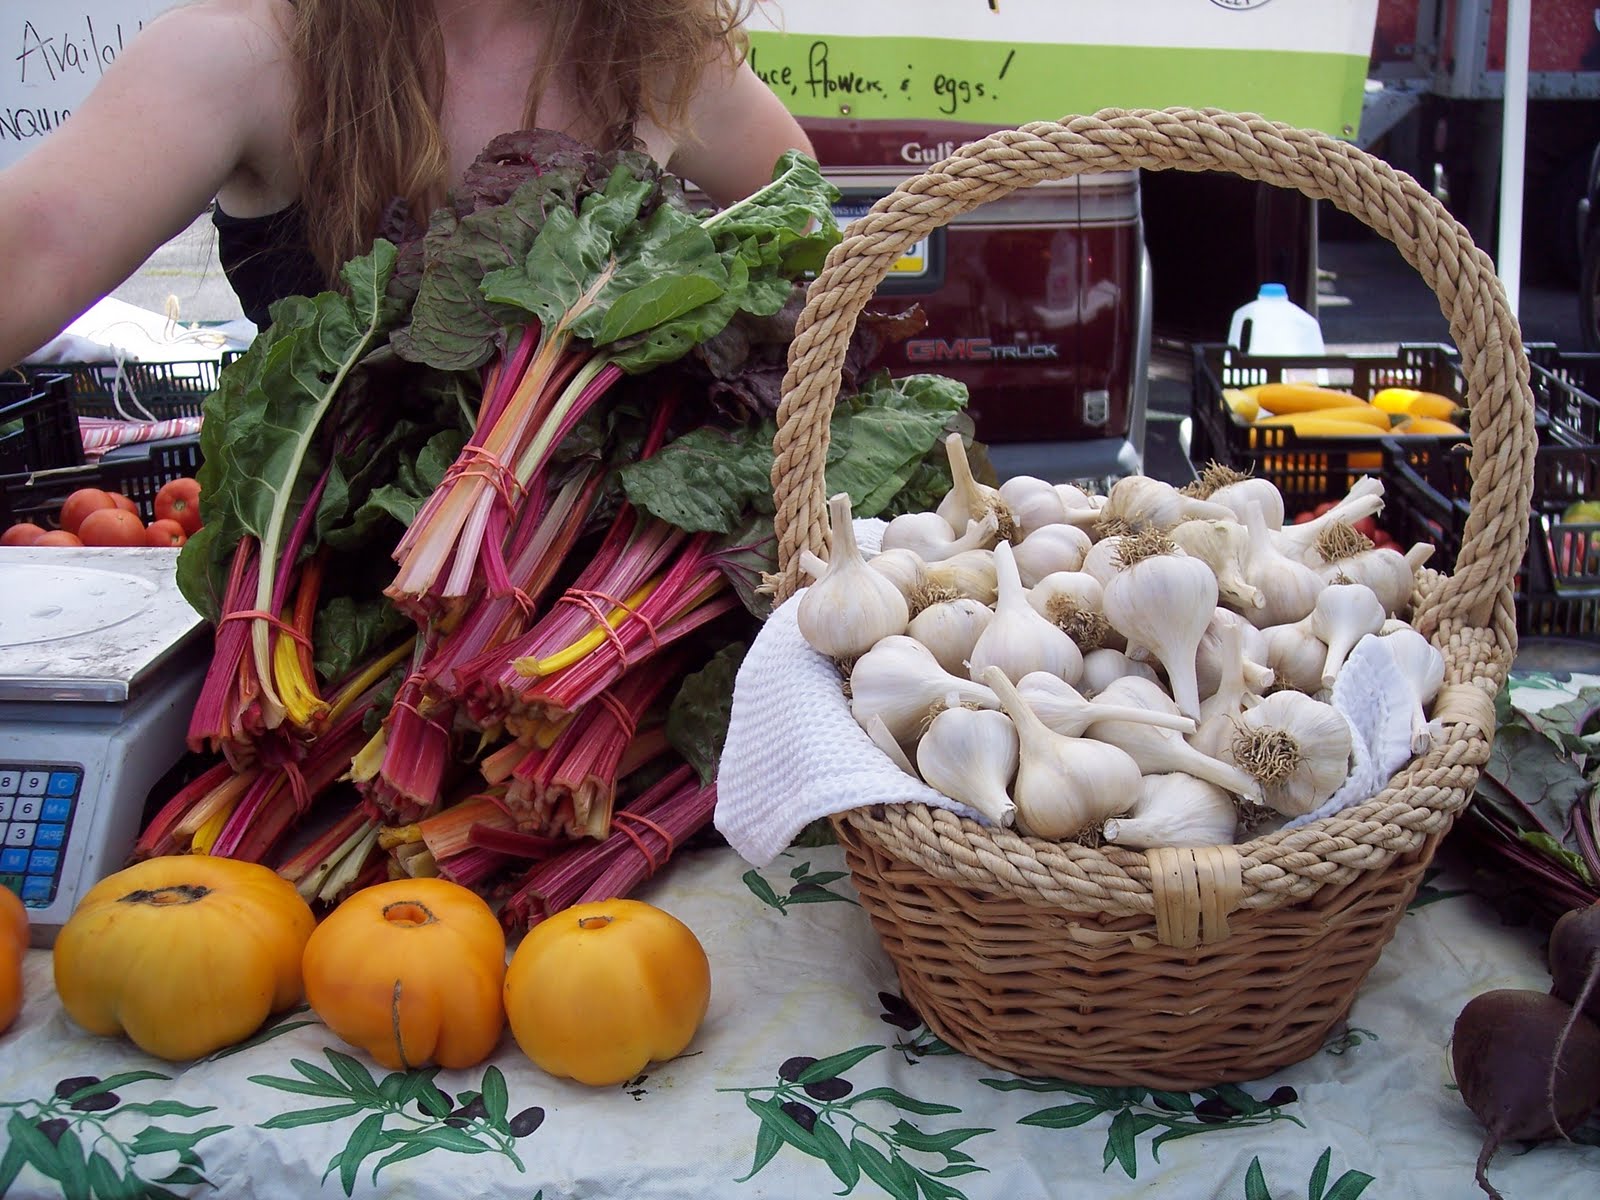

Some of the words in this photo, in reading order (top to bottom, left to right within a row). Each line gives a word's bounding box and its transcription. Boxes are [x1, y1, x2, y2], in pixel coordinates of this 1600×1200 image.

[934, 49, 1016, 115] eggs!
[901, 141, 954, 164] Gulf
[906, 338, 991, 361] GMC
[989, 344, 1059, 360] TRUCK
[1, 776, 11, 788] 8
[29, 777, 39, 788] 9
[58, 778, 69, 789] C
[22, 803, 33, 814] 6
[16, 828, 26, 839] 3
